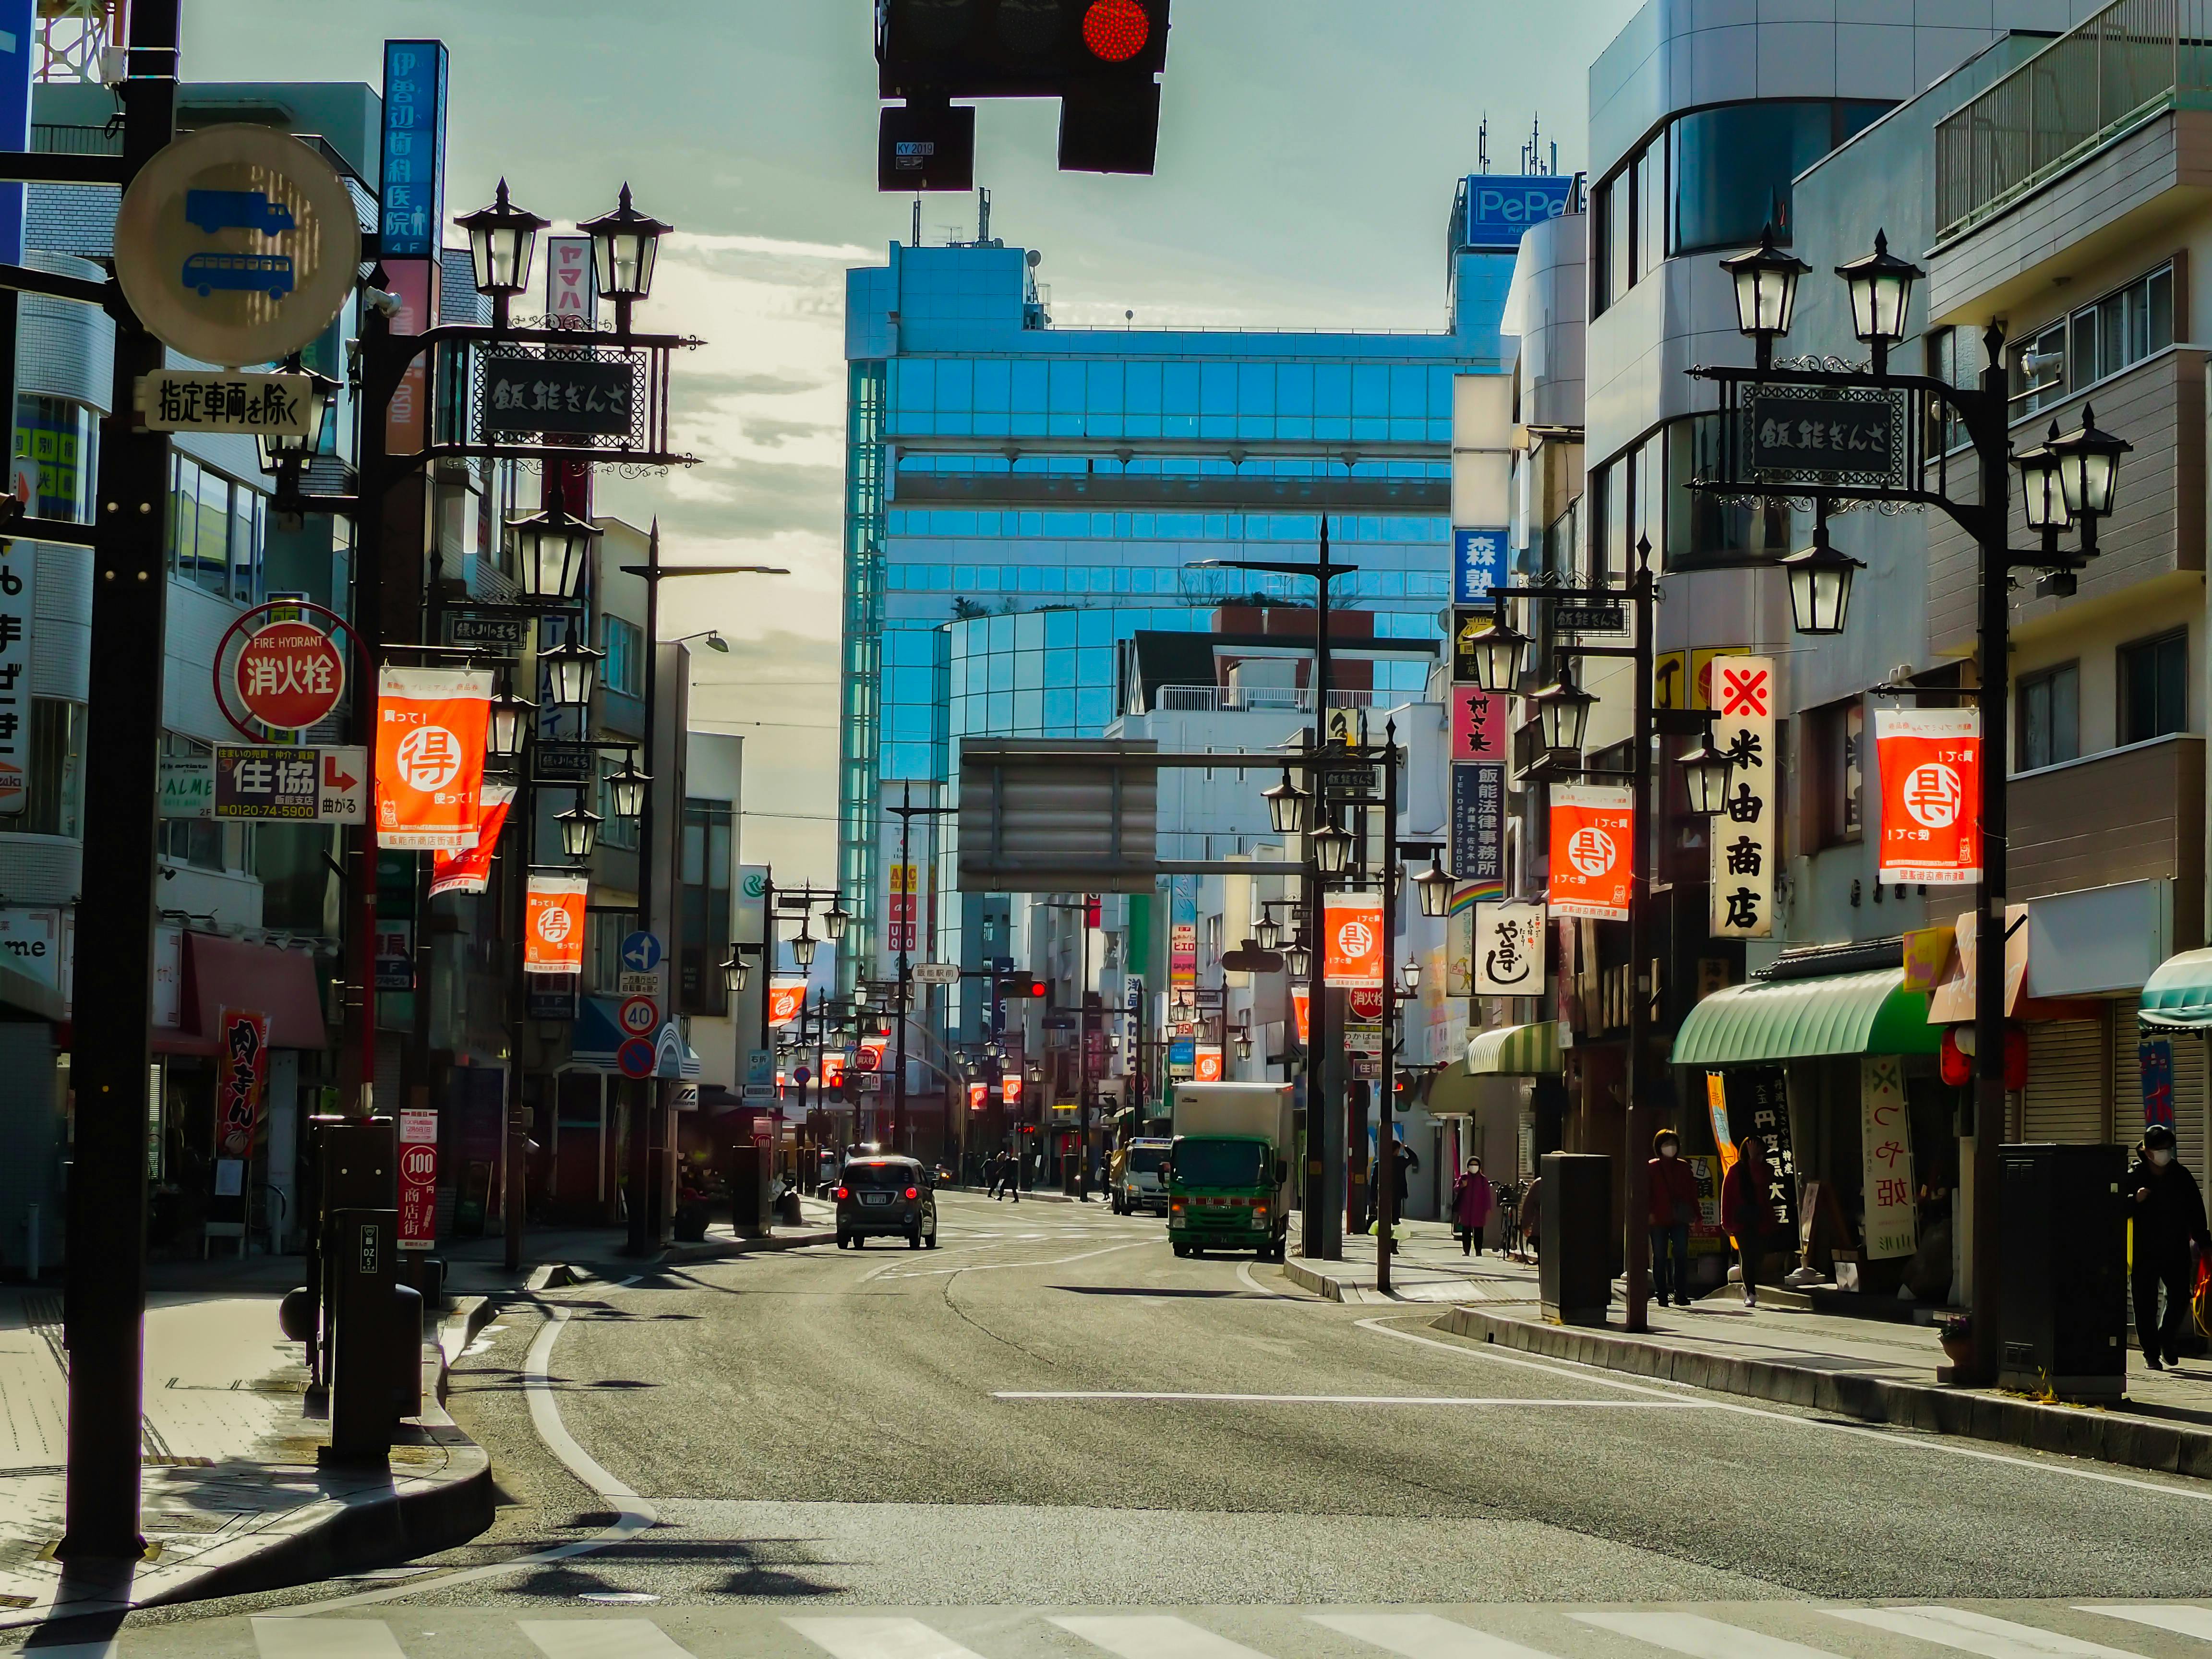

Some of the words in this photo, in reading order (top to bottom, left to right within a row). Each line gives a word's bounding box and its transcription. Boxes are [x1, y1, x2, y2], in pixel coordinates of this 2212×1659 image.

[898, 144, 909, 154] KY
[912, 144, 932, 154] 2019
[159, 379, 298, 426] 指定車両を除く
[492, 378, 629, 416] 飯能ぎんざ
[1759, 417, 1889, 453] 飯能ぎんざ
[1466, 537, 1495, 598] 森塾
[457, 622, 518, 640] 緑と川のまち
[253, 638, 275, 649] FIRE
[278, 636, 324, 649] HYDRANT
[247, 654, 335, 696] 消火栓
[1466, 695, 1492, 752] 村さ来
[401, 732, 456, 784] 得
[233, 759, 315, 794] 住協
[274, 795, 314, 805] 飯能支店
[323, 797, 356, 814] 曲がる
[229, 805, 314, 817] 0120-74-5900
[1478, 769, 1498, 876] 飯能法律事務所
[891, 868, 916, 880] AC
[540, 910, 568, 940] 得
[891, 926, 912, 936] UI
[891, 938, 913, 950] QO
[1174, 941, 1194, 951] ピエロ
[917, 969, 953, 977] 飯能駅前
[628, 1008, 649, 1025] 40
[857, 1056, 875, 1065] 消火栓
[228, 1018, 260, 1128] 肉まん
[1755, 1082, 1767, 1105] 大玉
[409, 1153, 433, 1174] 100
[426, 1185, 434, 1193] 円
[404, 1187, 420, 1236] 商店街
[363, 1248, 375, 1257] DZ
[366, 1258, 372, 1266] 5
